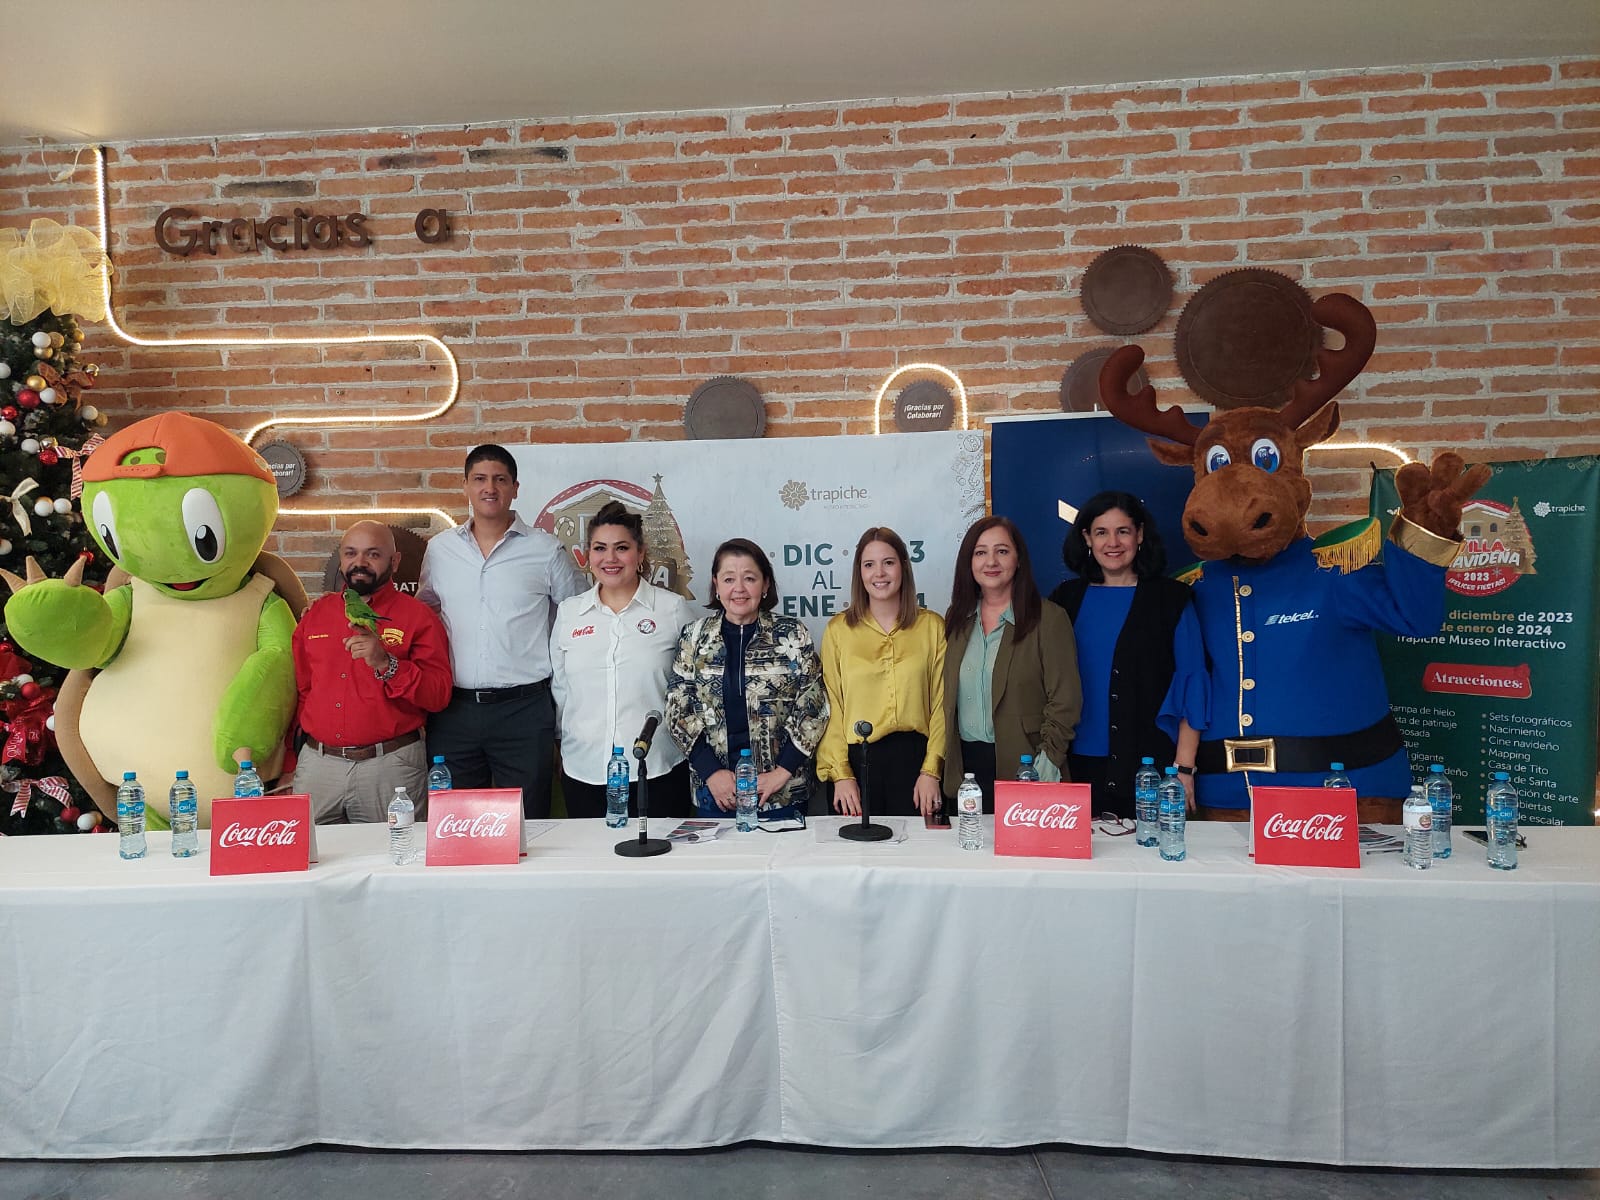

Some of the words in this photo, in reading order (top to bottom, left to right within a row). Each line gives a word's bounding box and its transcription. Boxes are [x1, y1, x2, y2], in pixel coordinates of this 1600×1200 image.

[154, 207, 371, 256] Gracias
[415, 208, 452, 244] a
[810, 485, 868, 504] trapiche
[1551, 504, 1586, 514] trapiche
[783, 543, 833, 566] DIC
[1449, 548, 1520, 568] AVIDEÑA
[811, 570, 842, 590] AL
[1463, 572, 1490, 582] 2023
[783, 595, 836, 618] ENE
[1278, 609, 1315, 624] telcel
[1449, 610, 1515, 621] diciembre
[1518, 612, 1535, 622] de
[1537, 612, 1573, 623] 2023
[1457, 626, 1495, 634] enero
[1497, 624, 1514, 634] de
[1516, 625, 1552, 636] 2024
[1449, 635, 1490, 647] Museo
[1493, 637, 1566, 650] Interactivo
[1432, 671, 1523, 689] Atracciones:
[1419, 706, 1431, 715] de
[1433, 708, 1456, 717] hielo
[1408, 717, 1420, 725] de
[1422, 719, 1458, 730] patinaje
[1489, 712, 1510, 722] Sets
[1511, 714, 1573, 728] fotográficos
[1489, 724, 1546, 738] Nacimiento
[1488, 736, 1512, 746] Cine
[1513, 740, 1560, 752] navideño
[1411, 752, 1445, 763] gigante
[1488, 748, 1531, 763] Mapping
[1487, 760, 1512, 770] Casa
[1513, 763, 1527, 773] de
[1529, 765, 1549, 775] Tito
[1513, 775, 1527, 785] de
[1528, 776, 1557, 789] Santa
[1542, 791, 1556, 802] de
[1558, 796, 1580, 804] arte
[1003, 802, 1082, 831] Coca-Cola
[1529, 814, 1565, 827] escalar
[435, 812, 511, 839] Coca-Cola
[1263, 812, 1347, 841] Coca-Cola
[219, 819, 301, 848] Coca-Cola
